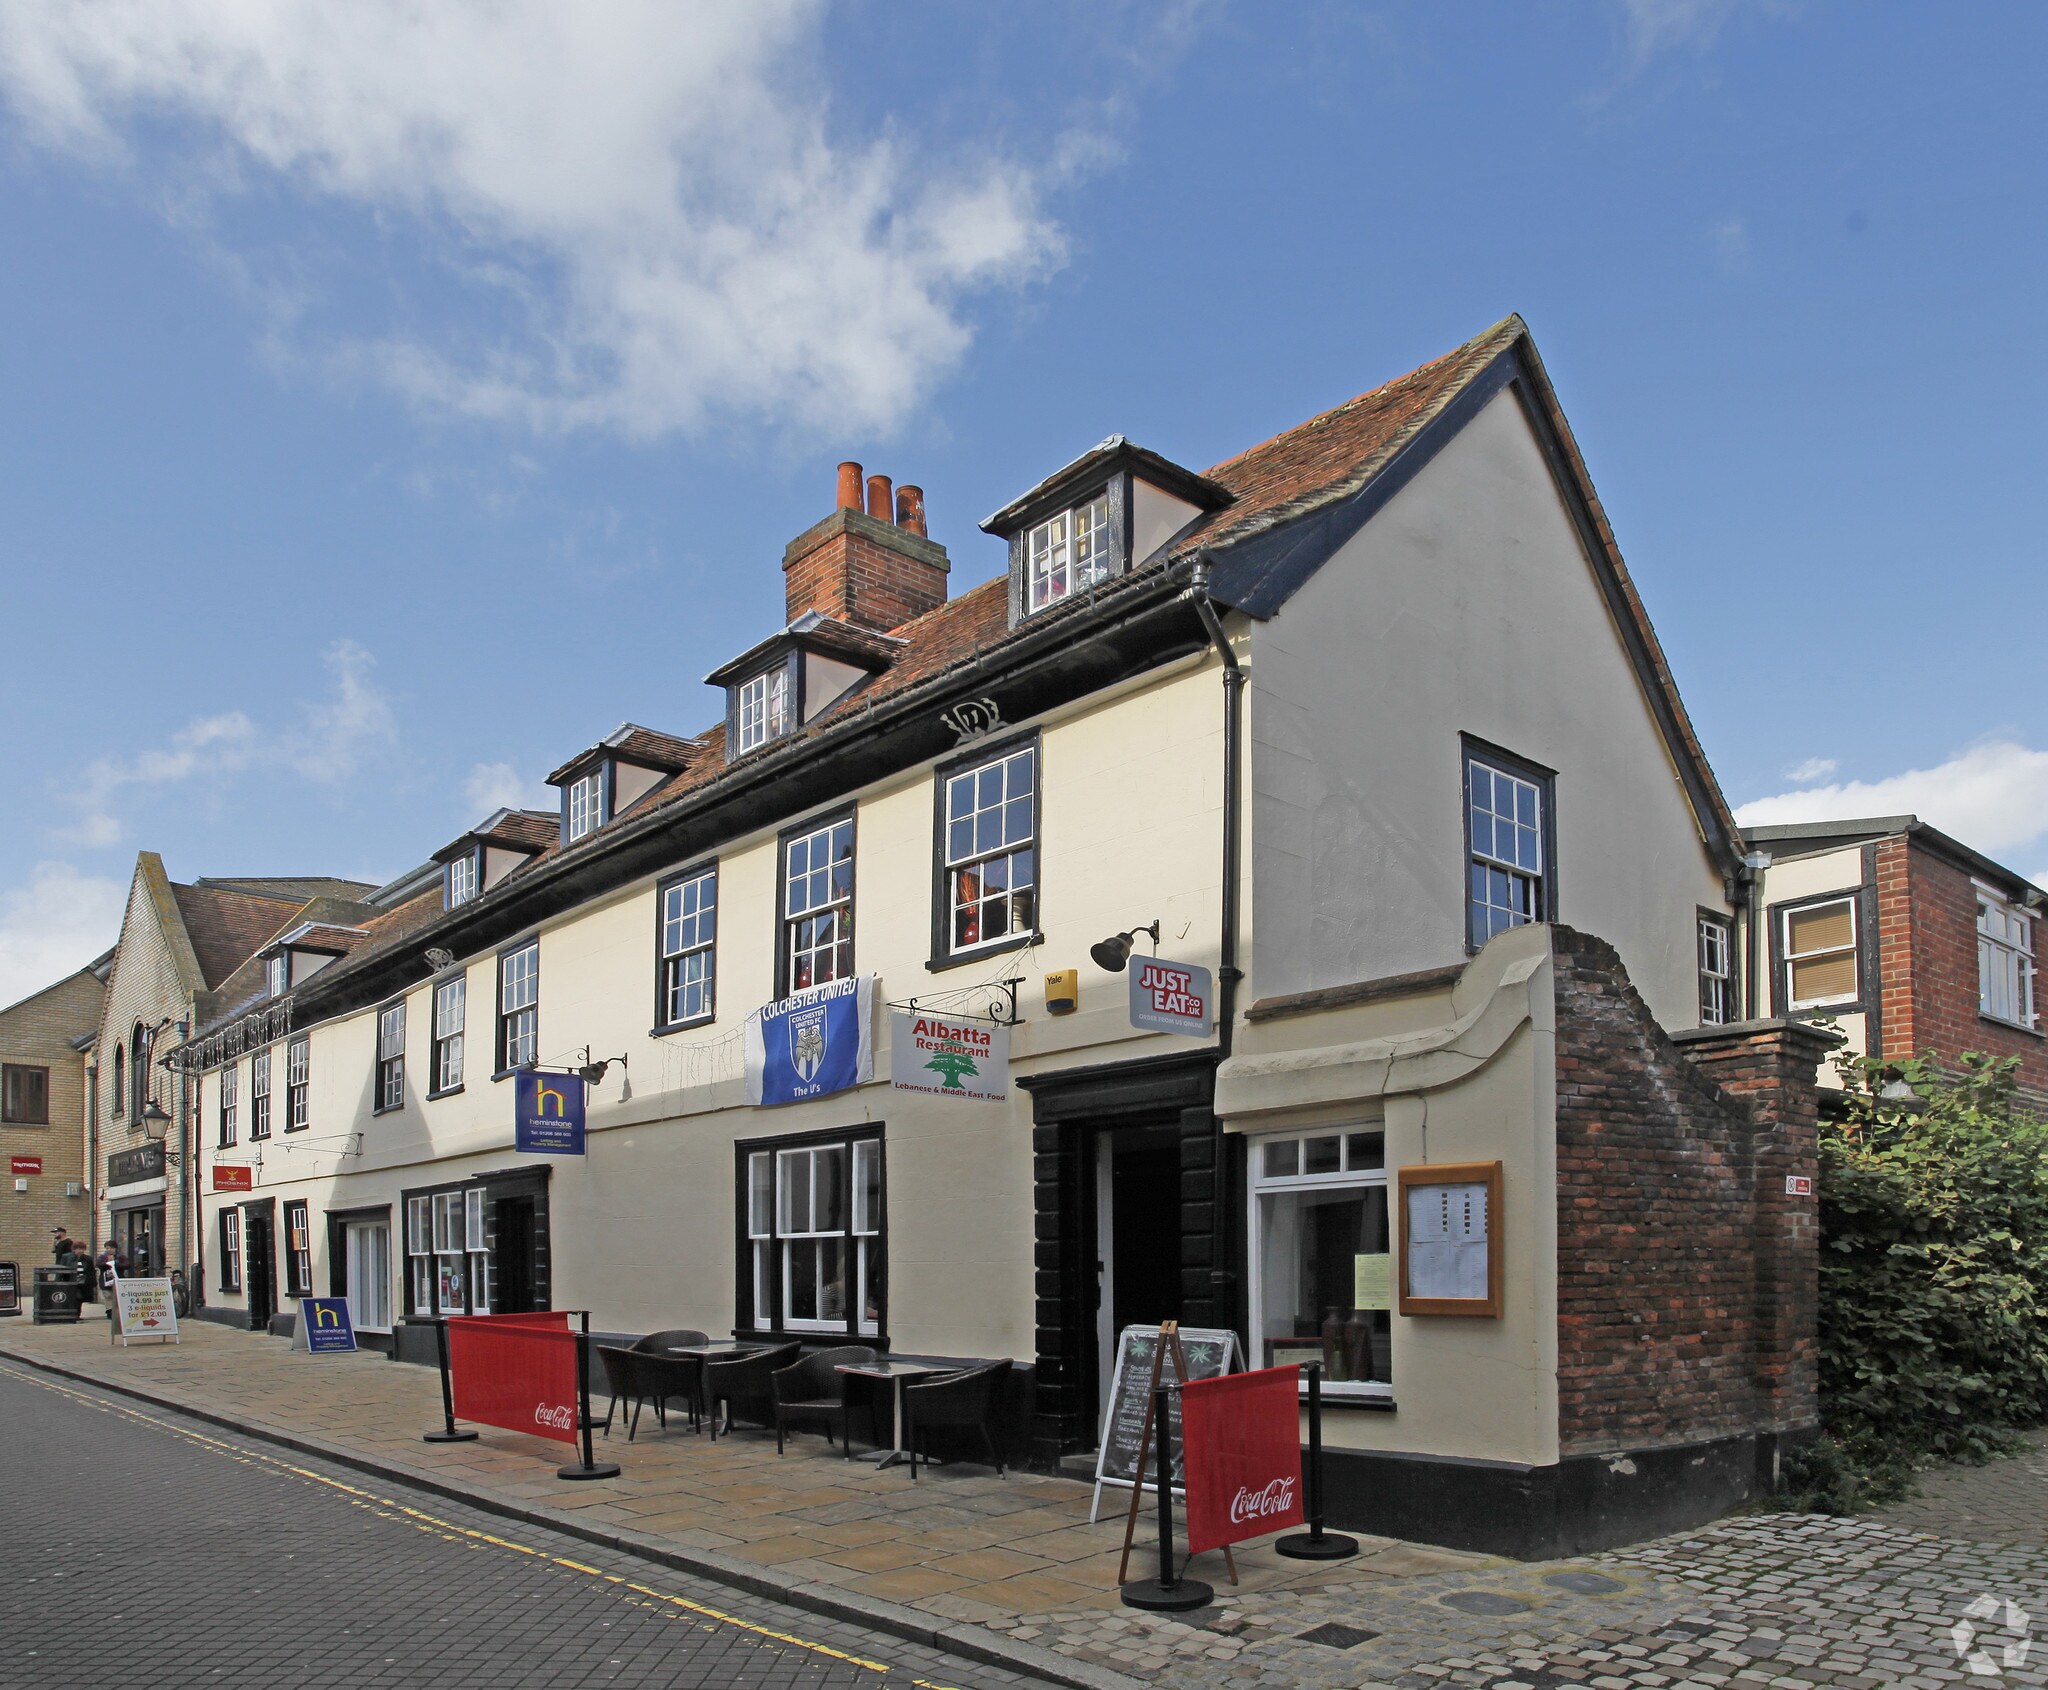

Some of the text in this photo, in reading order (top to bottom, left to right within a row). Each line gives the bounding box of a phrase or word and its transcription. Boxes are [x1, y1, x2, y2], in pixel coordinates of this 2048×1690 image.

[1046, 975, 1062, 985] Yale
[1141, 967, 1189, 993] JUST
[762, 978, 856, 1021] COLCHESTER UNITED
[1155, 991, 1188, 1013] EAT
[791, 1009, 825, 1024] COLCHESTER
[795, 1016, 822, 1029] UNITED FC
[1139, 1013, 1204, 1029] ORDER FROM US ONLINE
[912, 1019, 991, 1045] Albatta
[916, 1037, 990, 1058] Restaurant
[794, 1084, 820, 1097] The U's
[895, 1082, 932, 1093] Lebanese
[941, 1087, 966, 1097] Middle
[968, 1091, 984, 1099] East
[987, 1093, 1006, 1101] Food
[529, 1118, 572, 1128] heminstone
[121, 1290, 153, 1298] e-liquids
